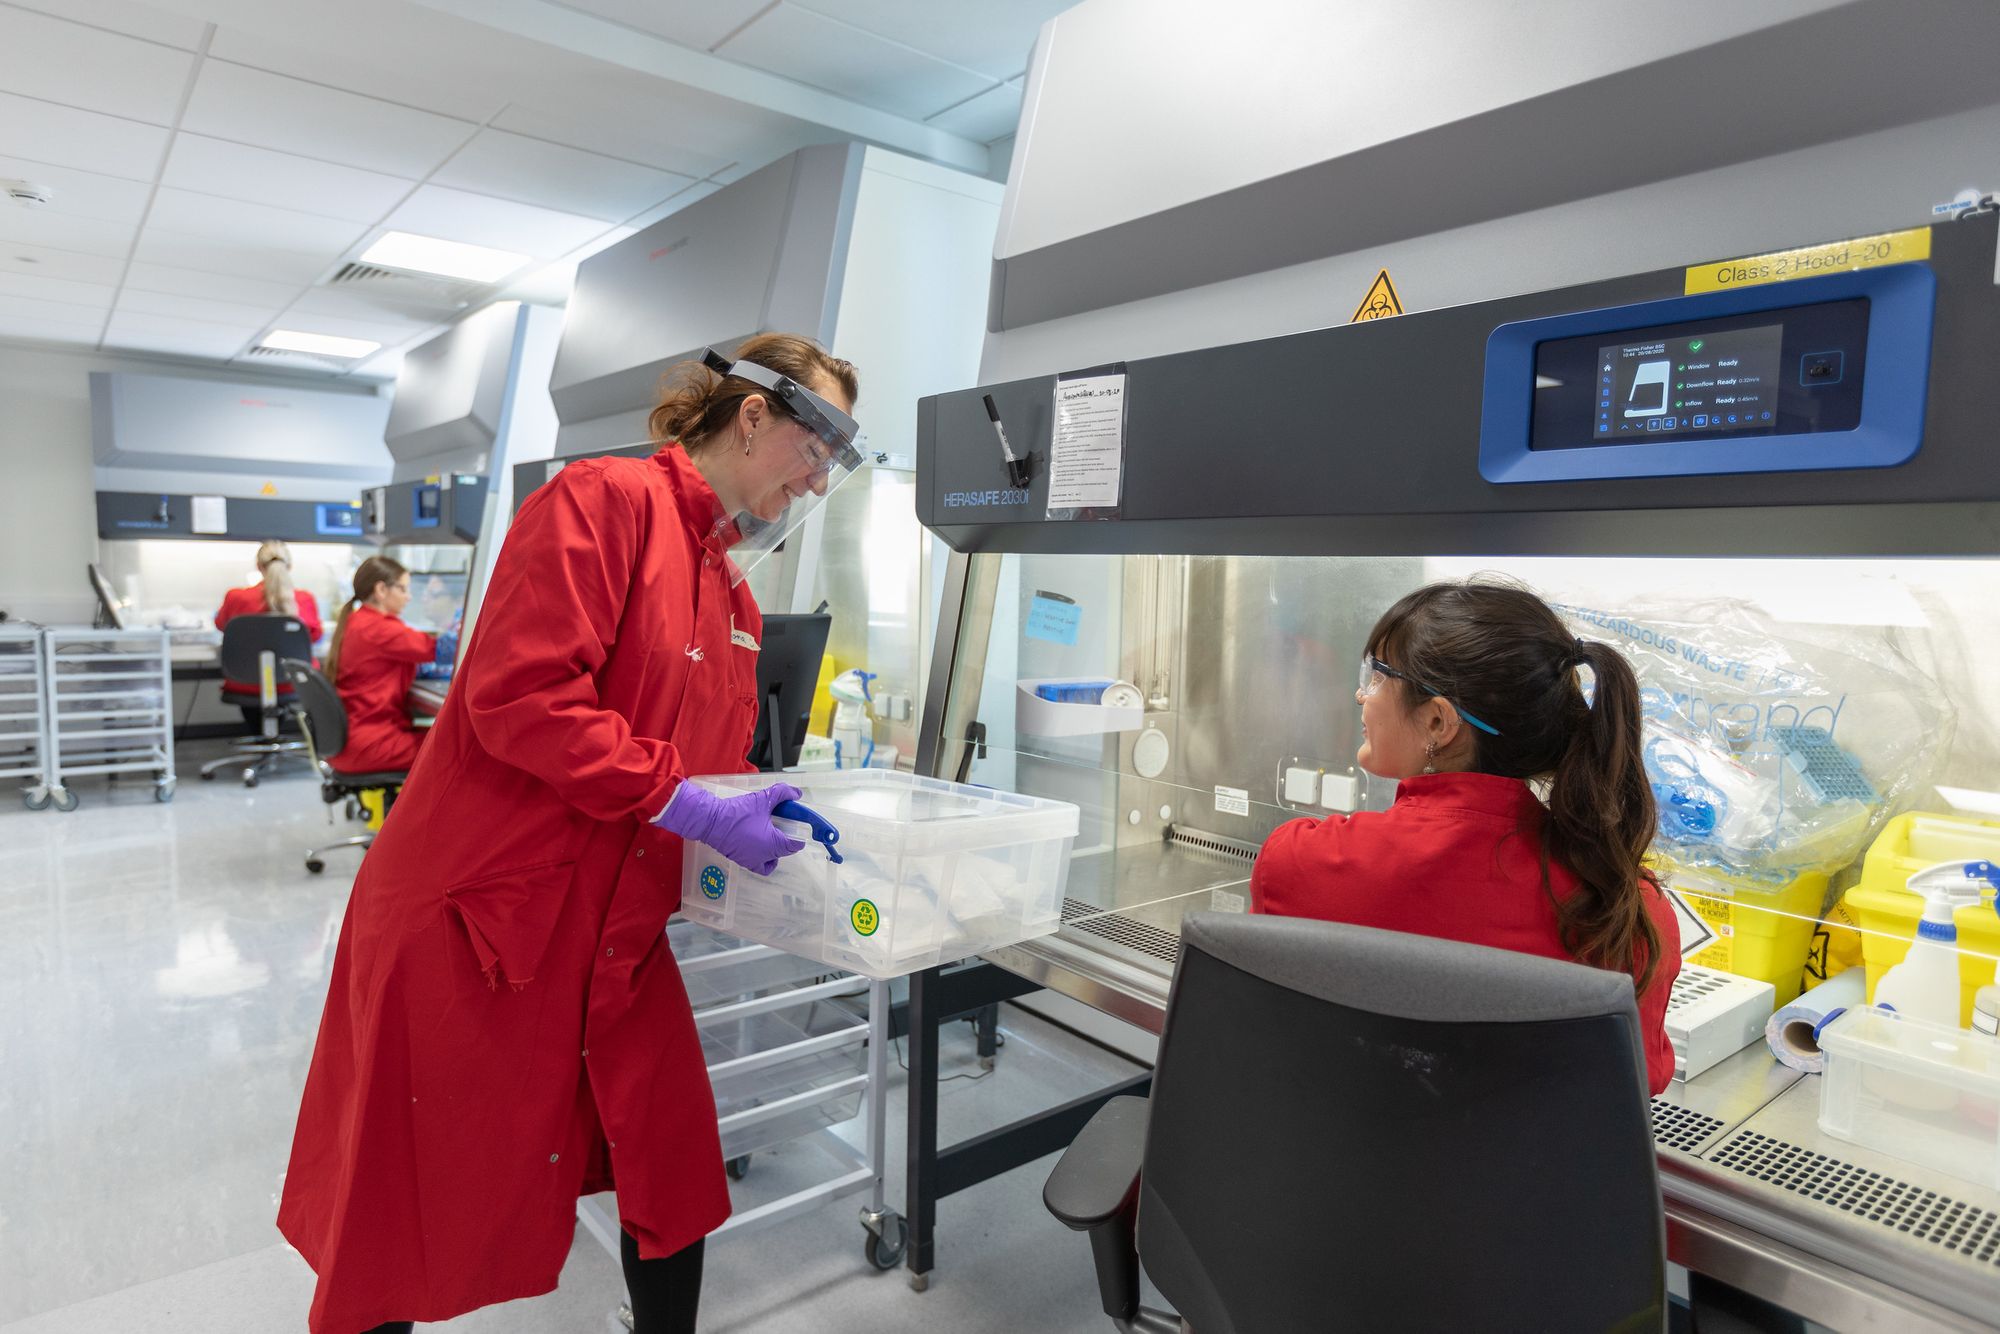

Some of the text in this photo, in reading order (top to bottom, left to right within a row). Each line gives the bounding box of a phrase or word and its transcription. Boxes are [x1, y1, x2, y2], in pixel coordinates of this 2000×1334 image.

[1717, 241, 1891, 284] Class 2 Hood-20
[1718, 359, 1738, 367] Ready
[1686, 381, 1714, 389] Downflow
[1717, 378, 1737, 386] Ready
[1715, 396, 1735, 404] Ready
[944, 489, 1029, 507] HERASAFE 2030i
[1682, 643, 1750, 682] WASTE
